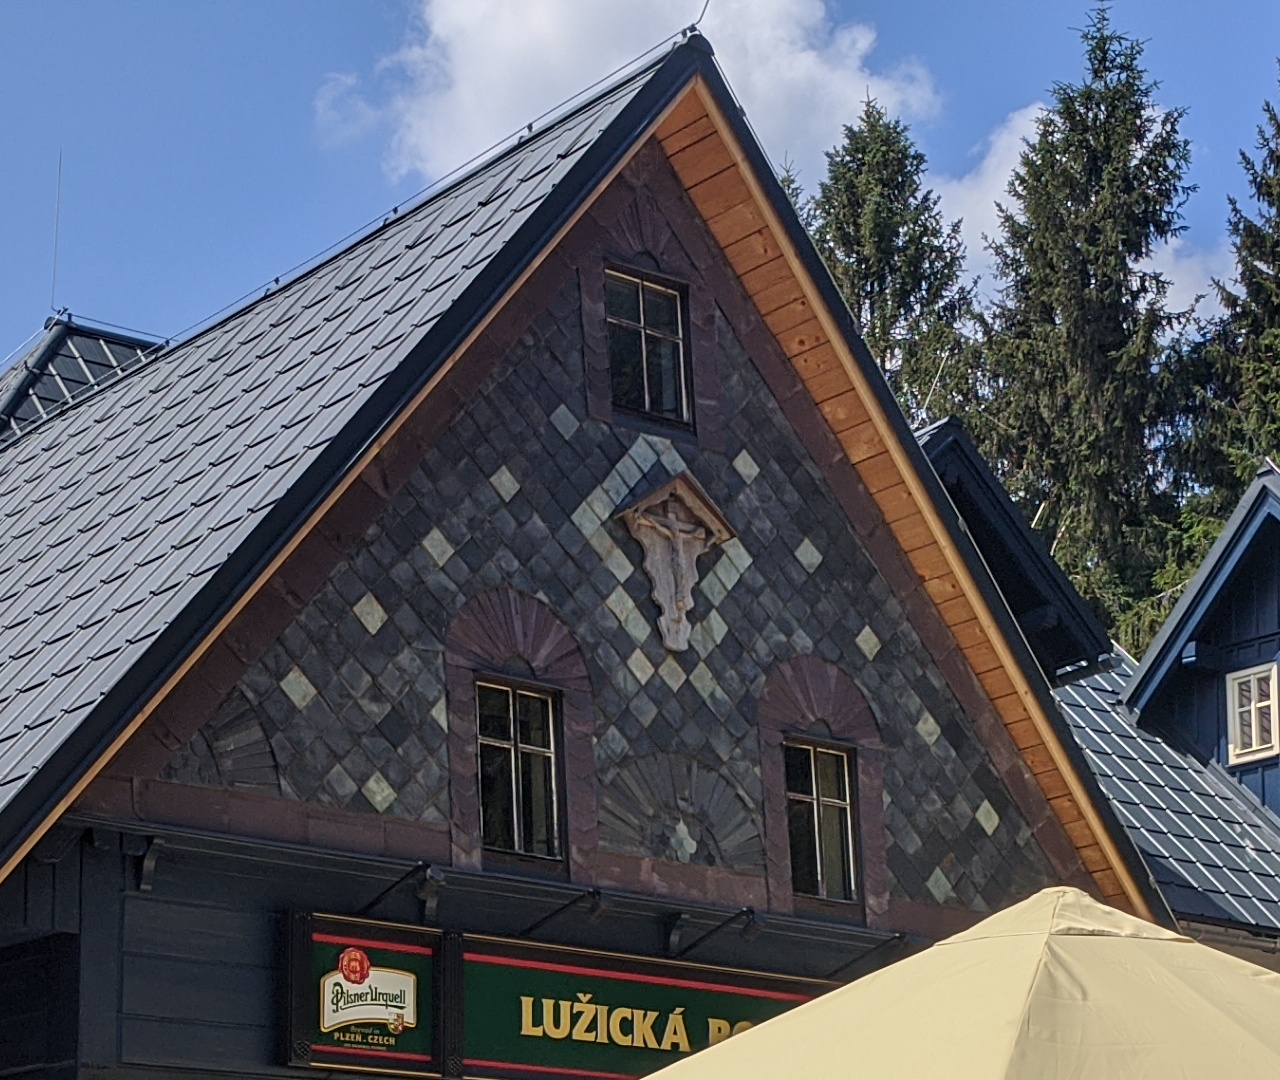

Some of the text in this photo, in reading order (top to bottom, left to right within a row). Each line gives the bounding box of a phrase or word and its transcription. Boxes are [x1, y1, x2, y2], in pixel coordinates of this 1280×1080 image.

[331, 982, 406, 1013] Pilsner Urquell
[520, 993, 691, 1051] LUŽICKÁ
[368, 1034, 396, 1045] CZECH
